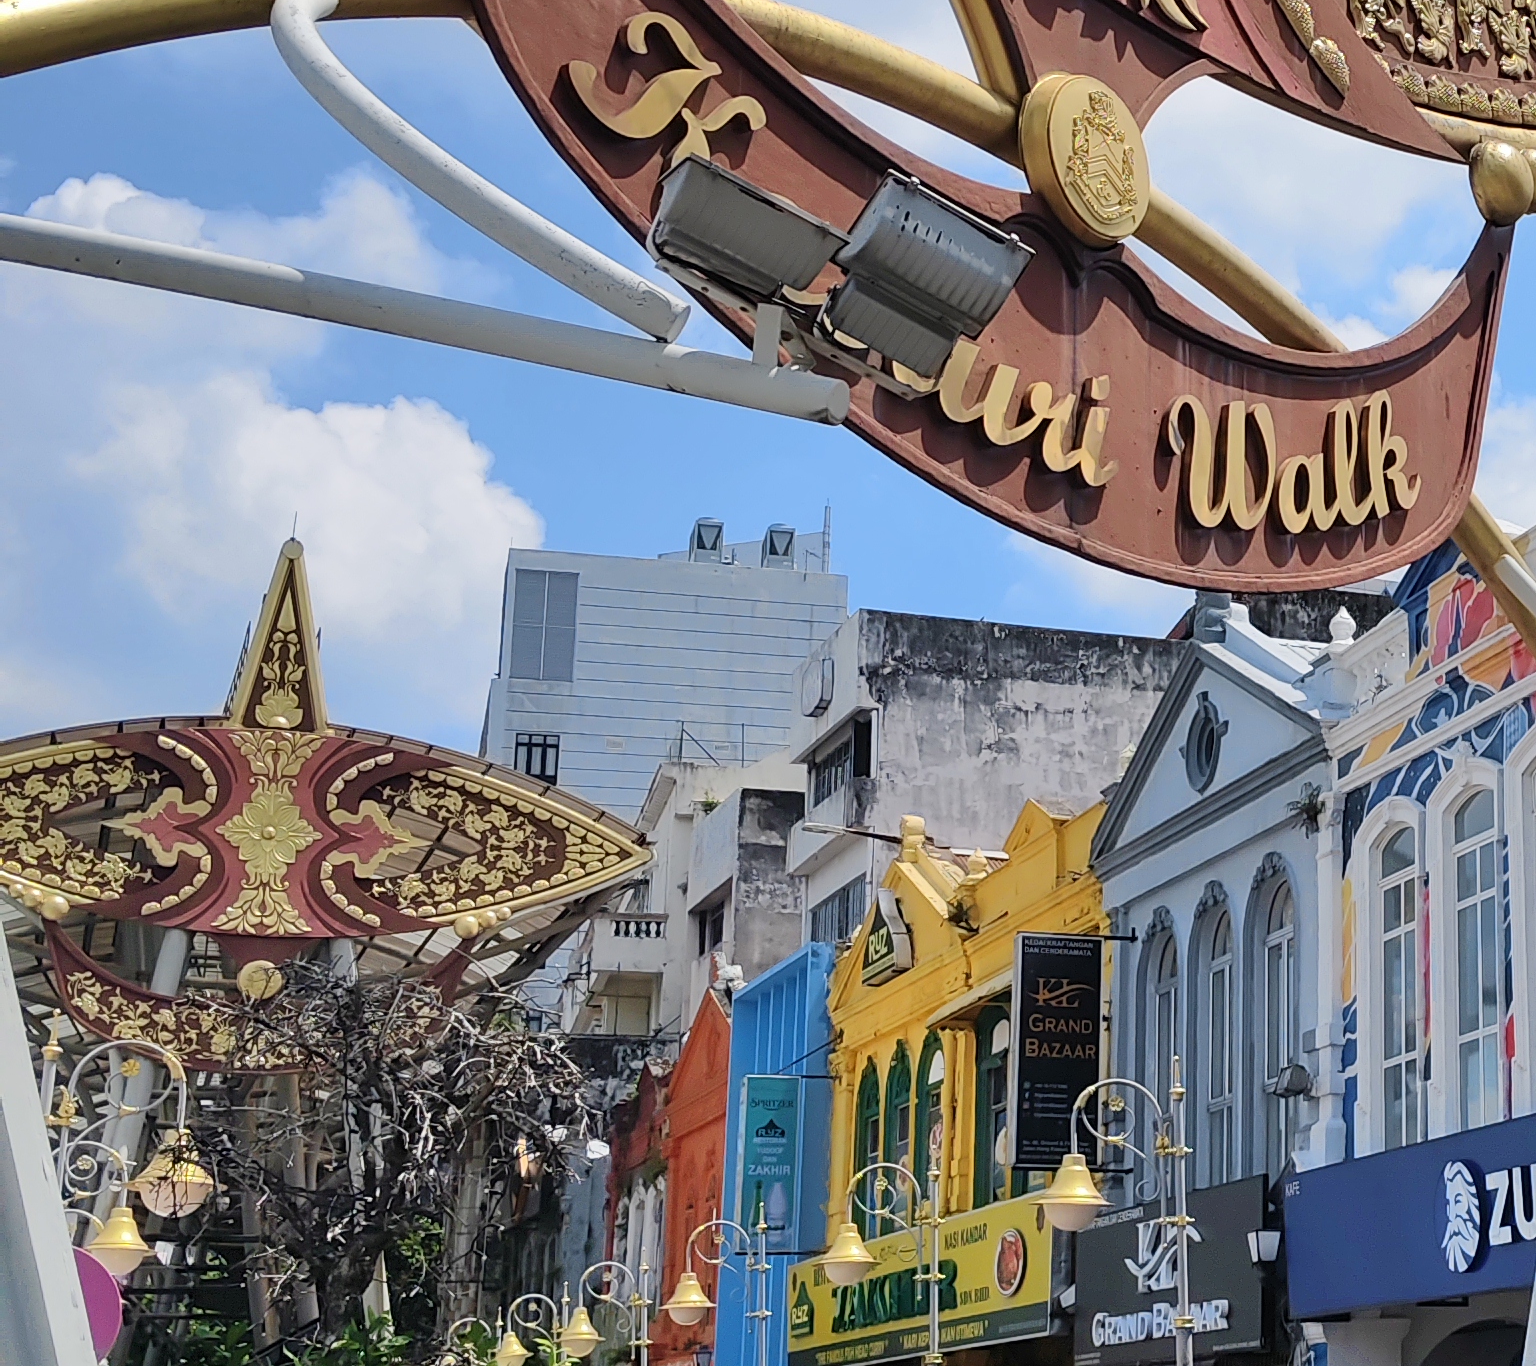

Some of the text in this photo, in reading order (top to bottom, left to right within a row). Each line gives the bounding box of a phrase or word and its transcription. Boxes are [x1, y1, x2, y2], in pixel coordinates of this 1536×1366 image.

[569, 11, 1421, 534] Kuri Walk
[1028, 1014, 1093, 1034] GRAND
[1025, 1038, 1097, 1060] BAZAAR
[750, 1099, 794, 1111] SPRITZER
[748, 1164, 791, 1176] ZAKHIR
[1285, 1181, 1300, 1198] KAFE
[944, 1223, 988, 1251] NASI KANDAR
[1092, 1299, 1229, 1348] GRAND BAAAR
